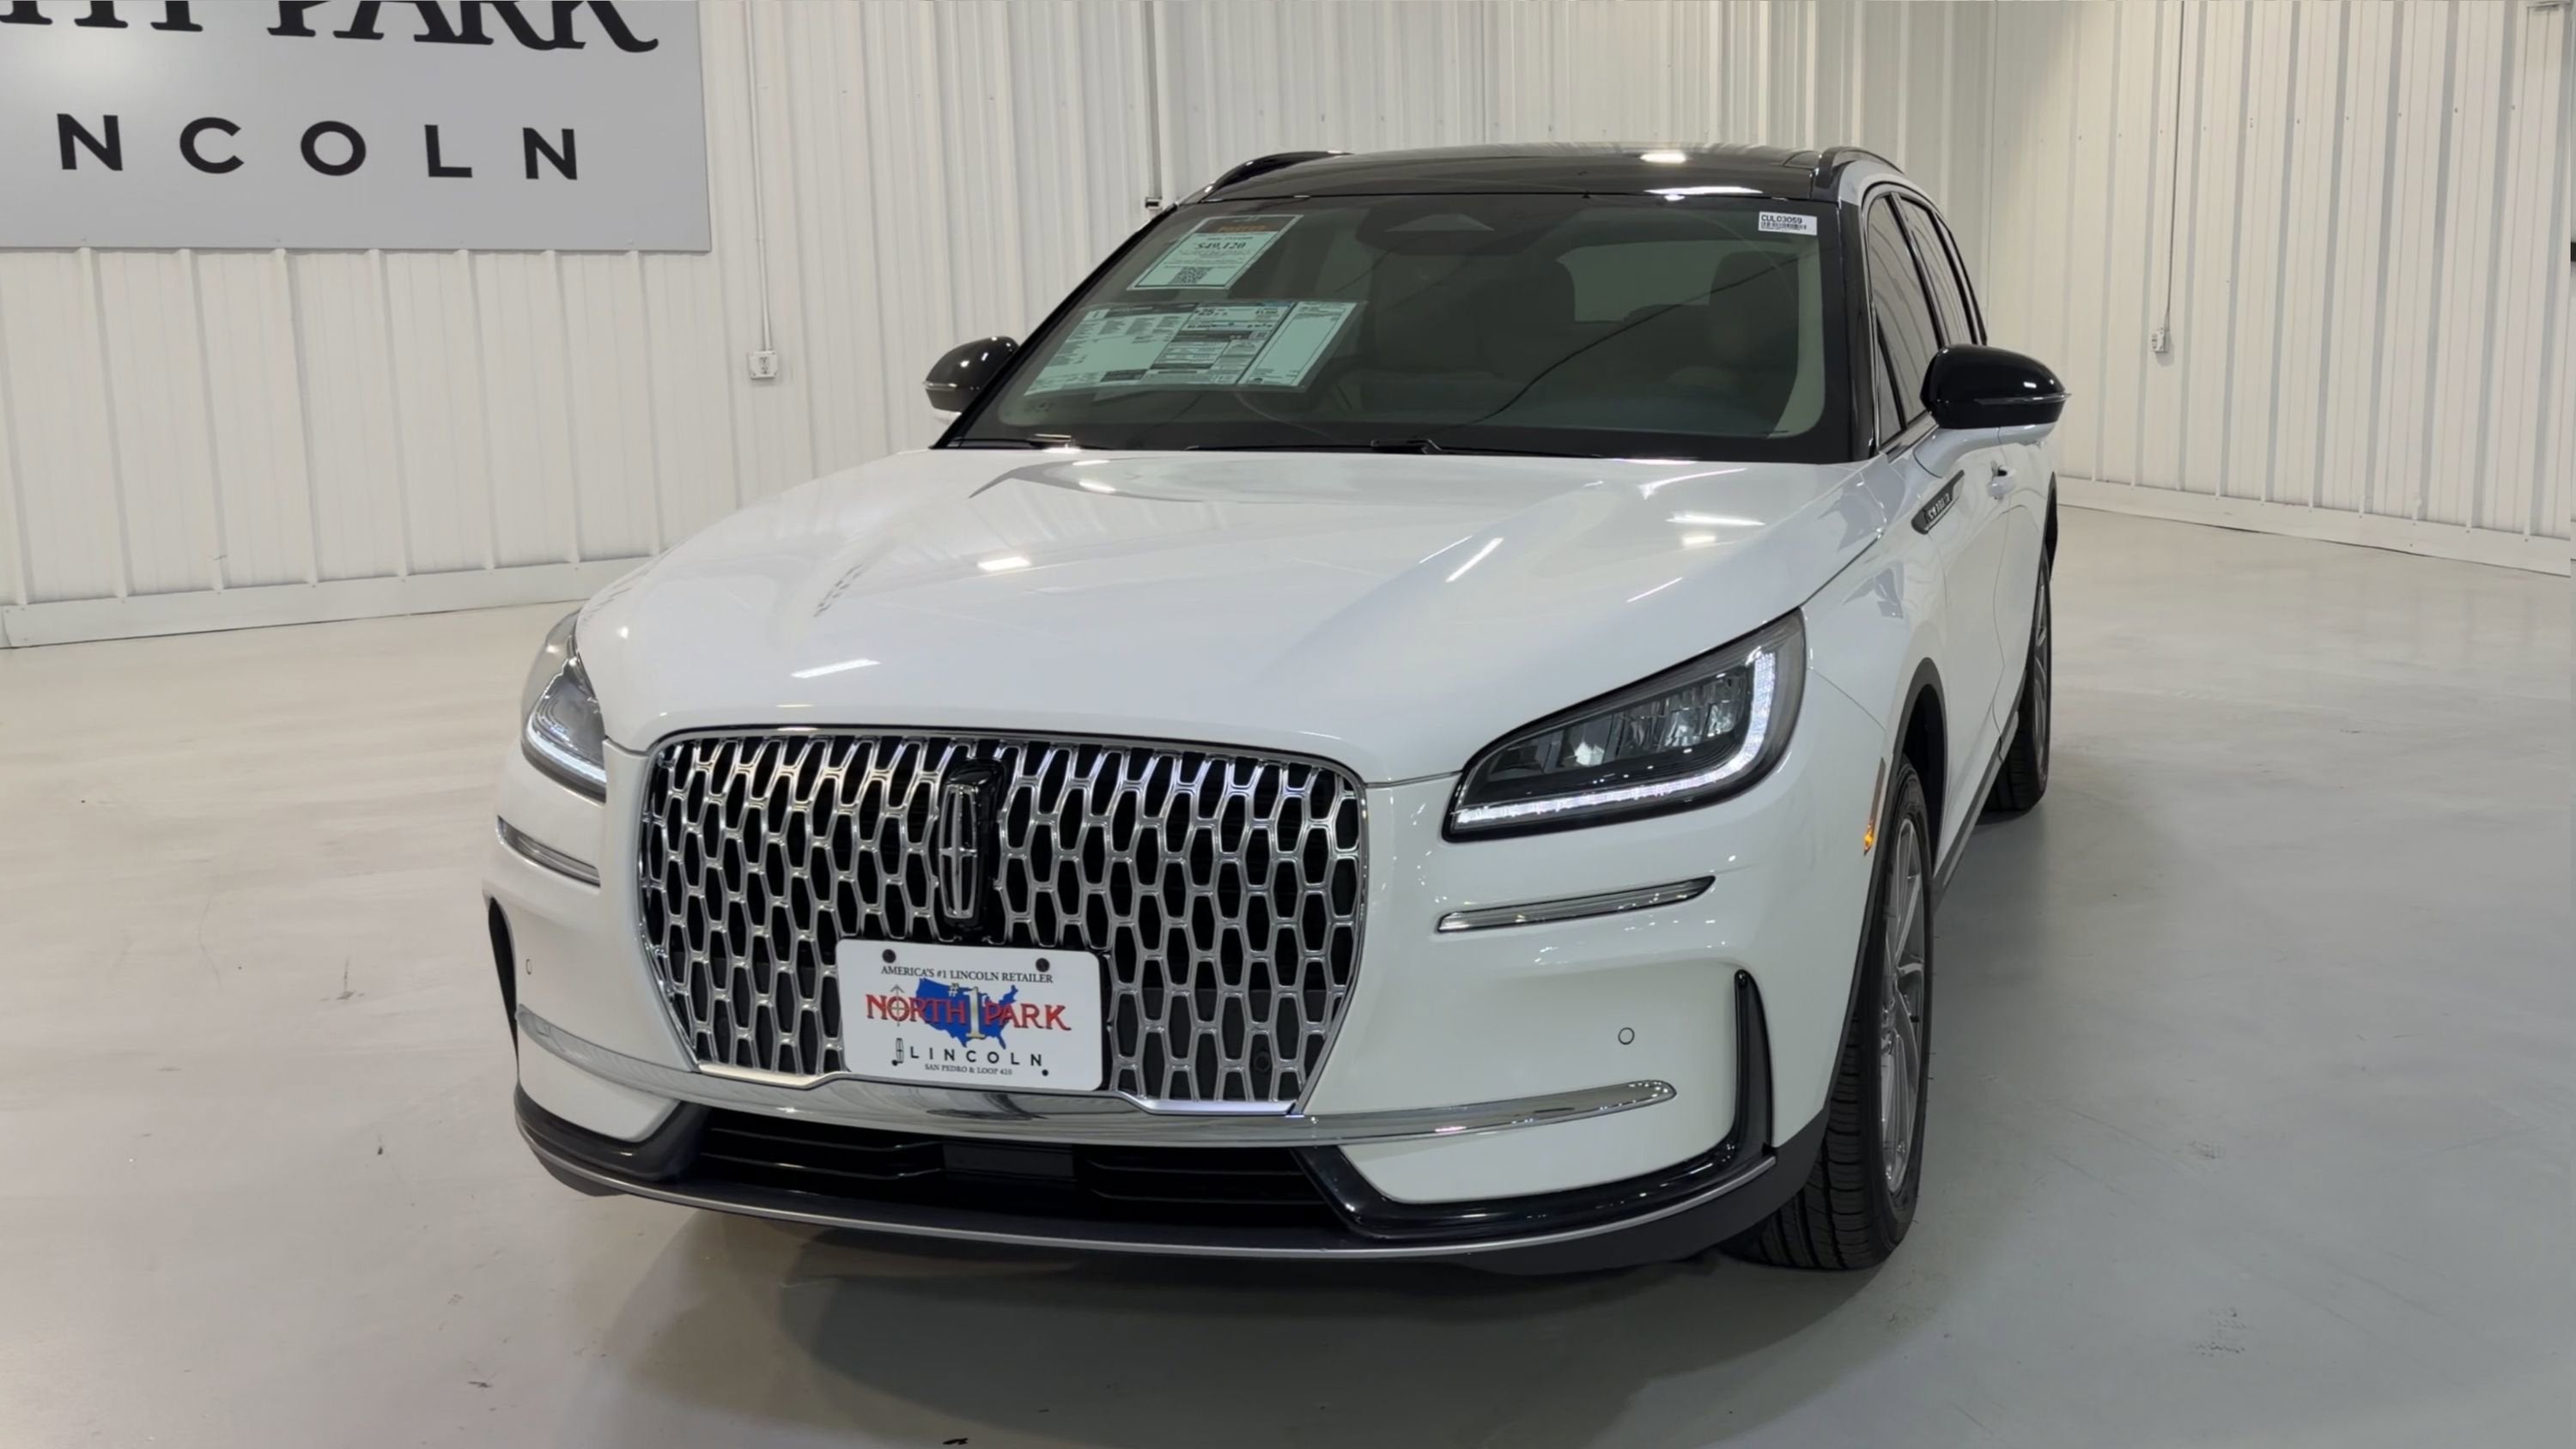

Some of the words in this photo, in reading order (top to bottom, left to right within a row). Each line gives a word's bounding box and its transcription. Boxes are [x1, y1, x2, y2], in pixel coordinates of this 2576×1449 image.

[881, 966, 934, 978] AMERICA'S
[937, 970, 947, 979] #1
[950, 970, 999, 981] LINCOLN
[1001, 972, 1054, 984] RETAILER
[866, 994, 967, 1025] NORTH
[984, 1002, 1072, 1031] PARK
[909, 1046, 1042, 1066] LINCOLN
